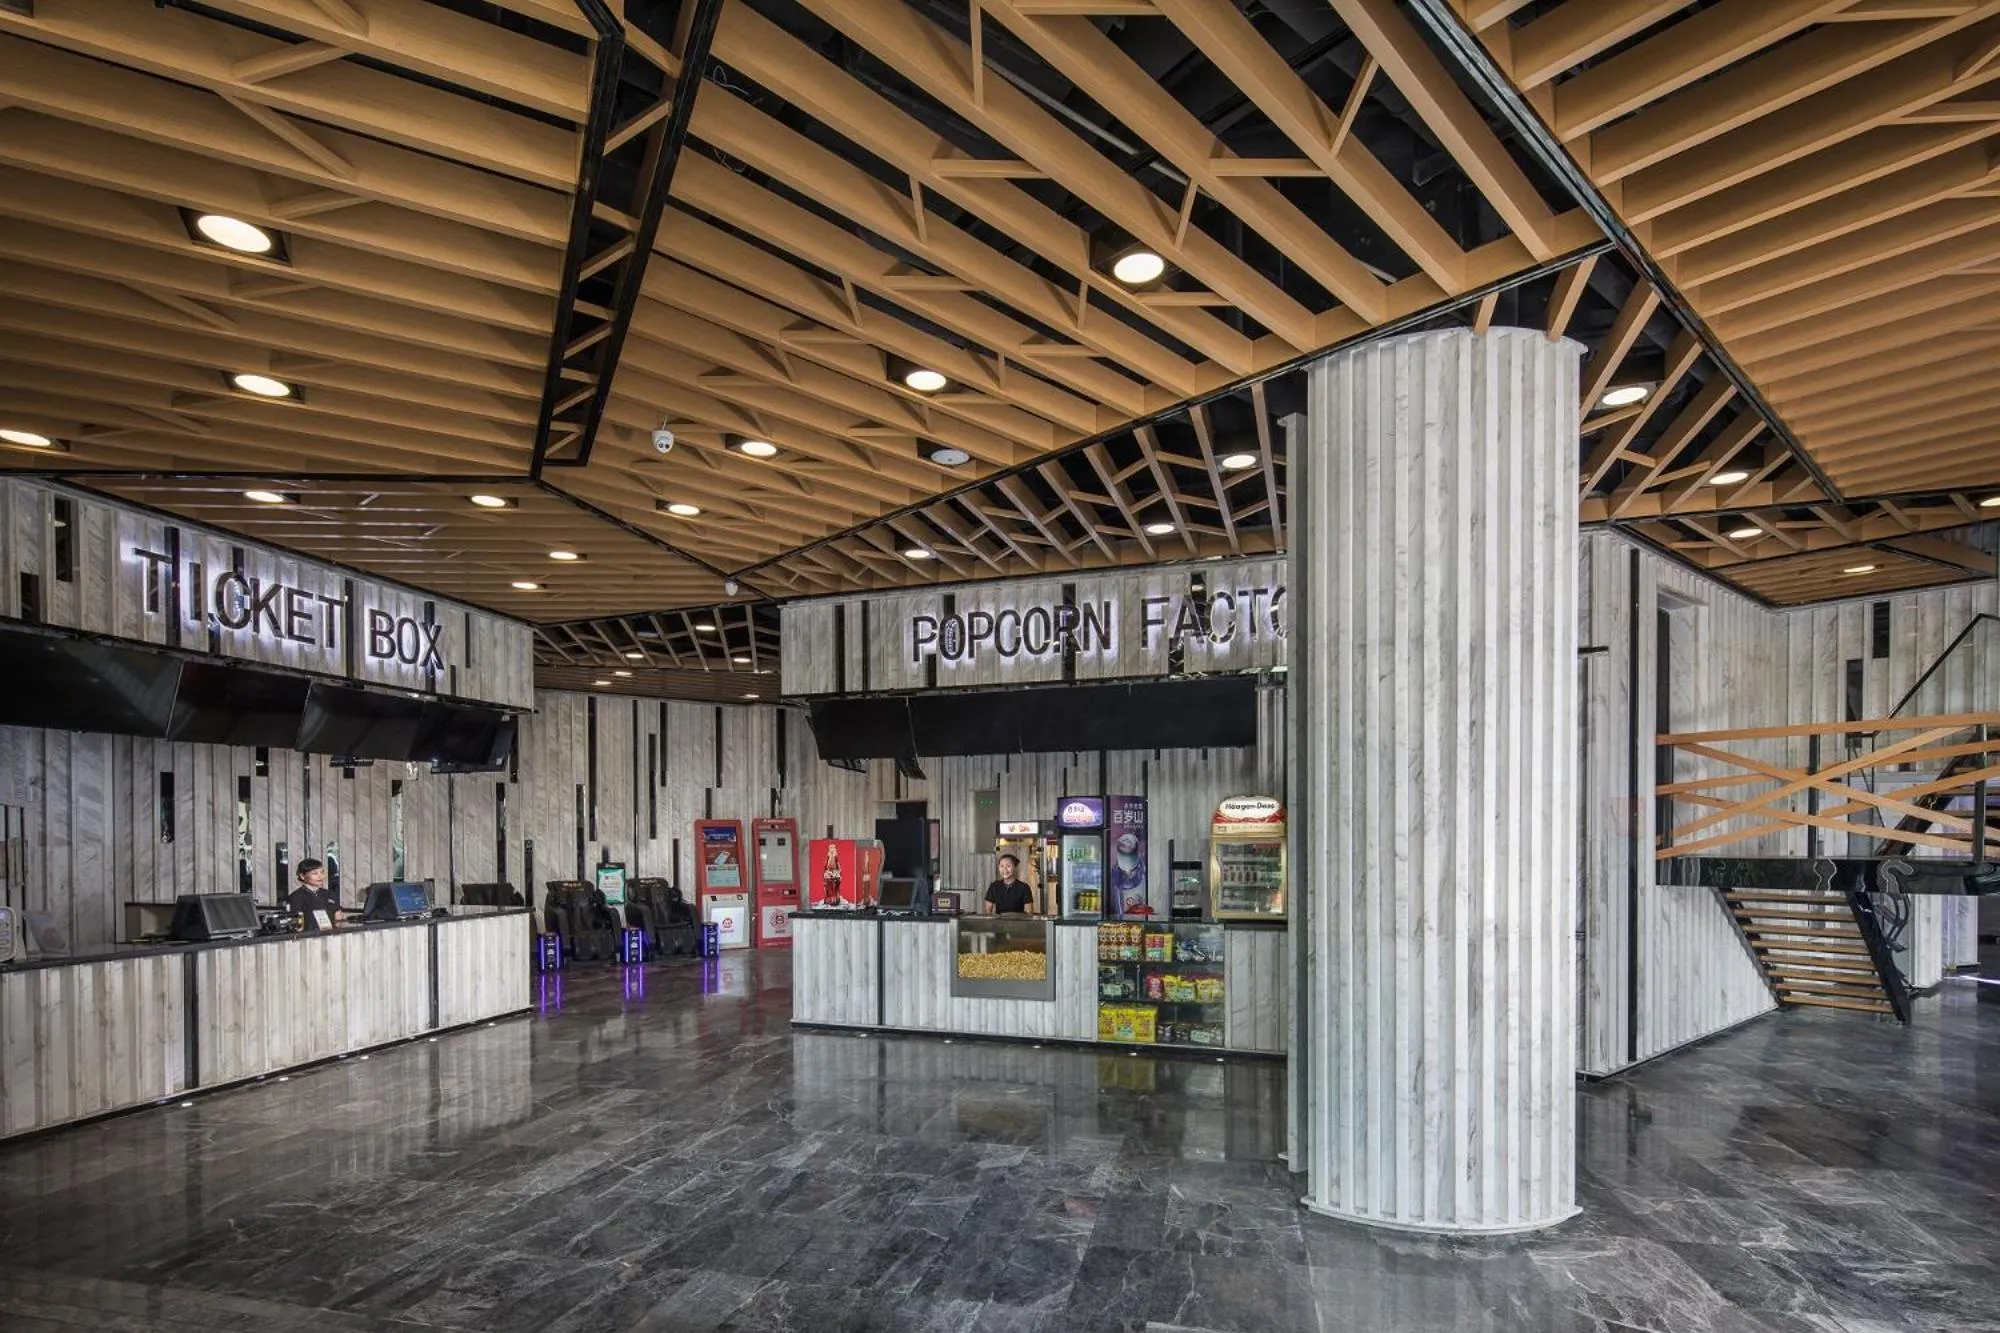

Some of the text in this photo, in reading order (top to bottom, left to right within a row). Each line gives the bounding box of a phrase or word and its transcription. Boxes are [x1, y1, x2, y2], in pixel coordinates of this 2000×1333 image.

[133, 548, 444, 670] TICKET BOX
[912, 600, 1112, 662] POPCORN
[1112, 810, 1143, 824] 百岁山
